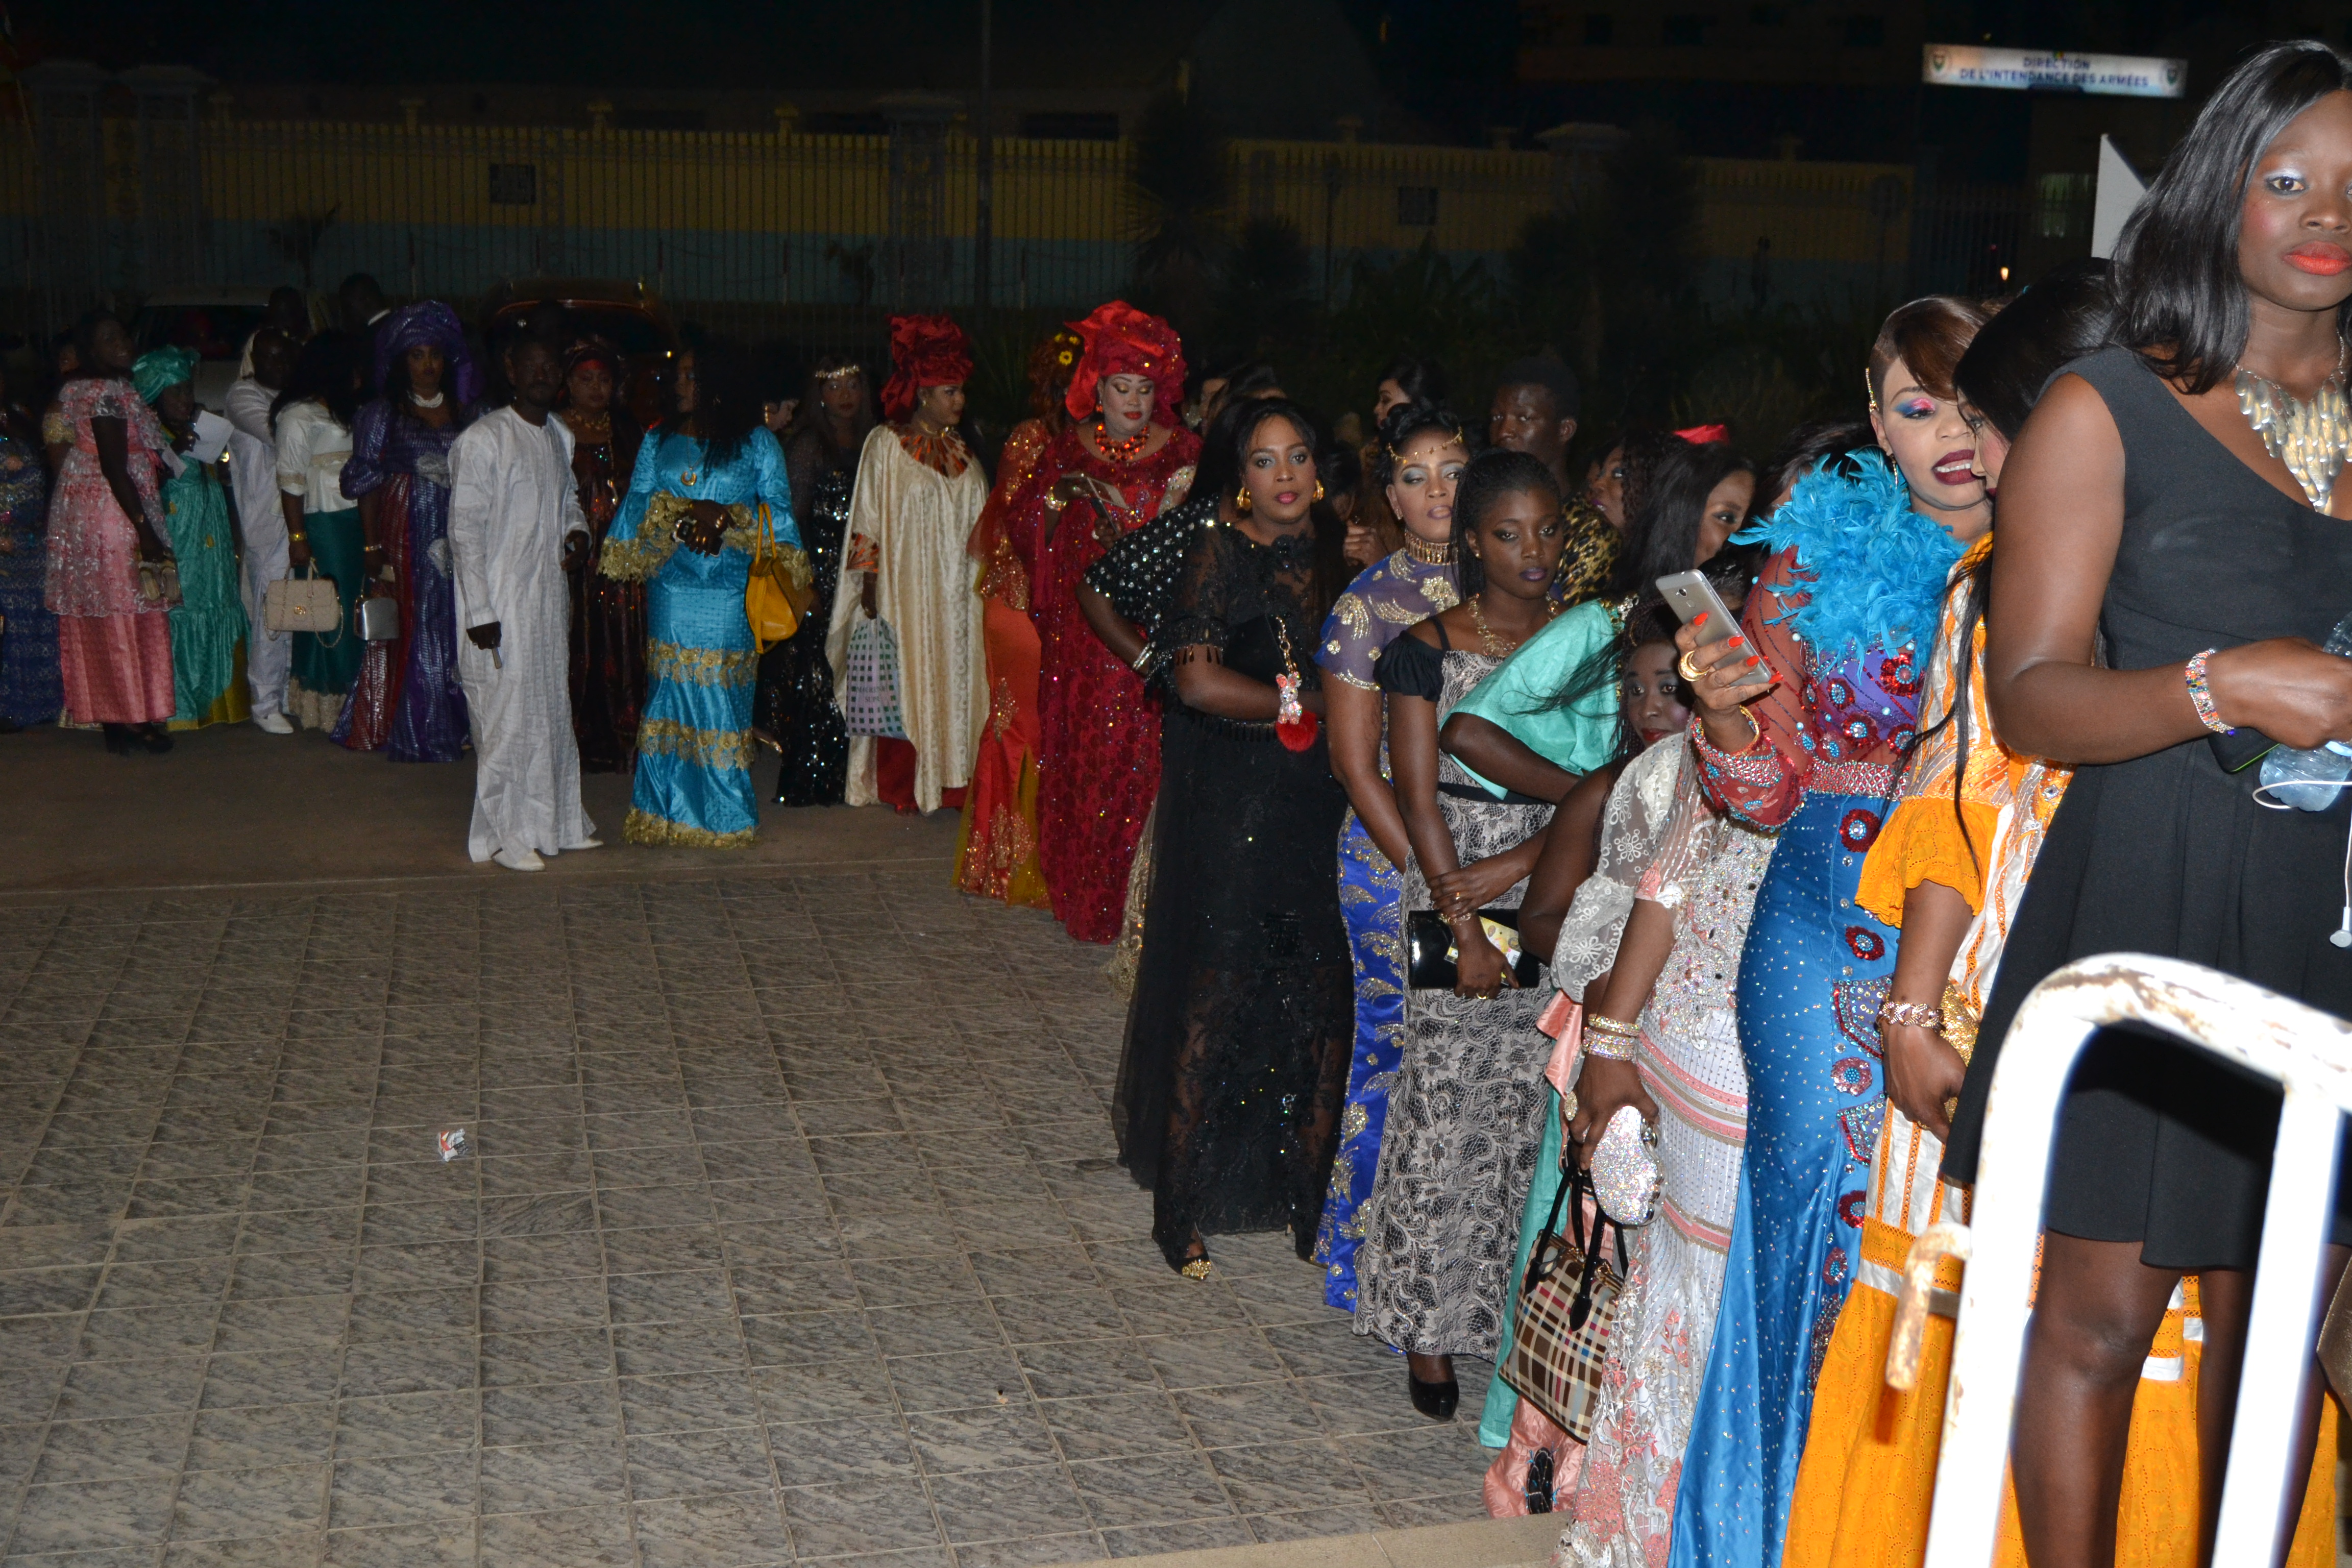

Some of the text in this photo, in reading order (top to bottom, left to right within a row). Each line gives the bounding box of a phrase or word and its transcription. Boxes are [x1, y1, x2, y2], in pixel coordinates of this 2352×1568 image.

[2023, 56, 2090, 69] DIRECTION
[1959, 68, 2149, 87] DE L'INTENDANCE DES ARMÉES
